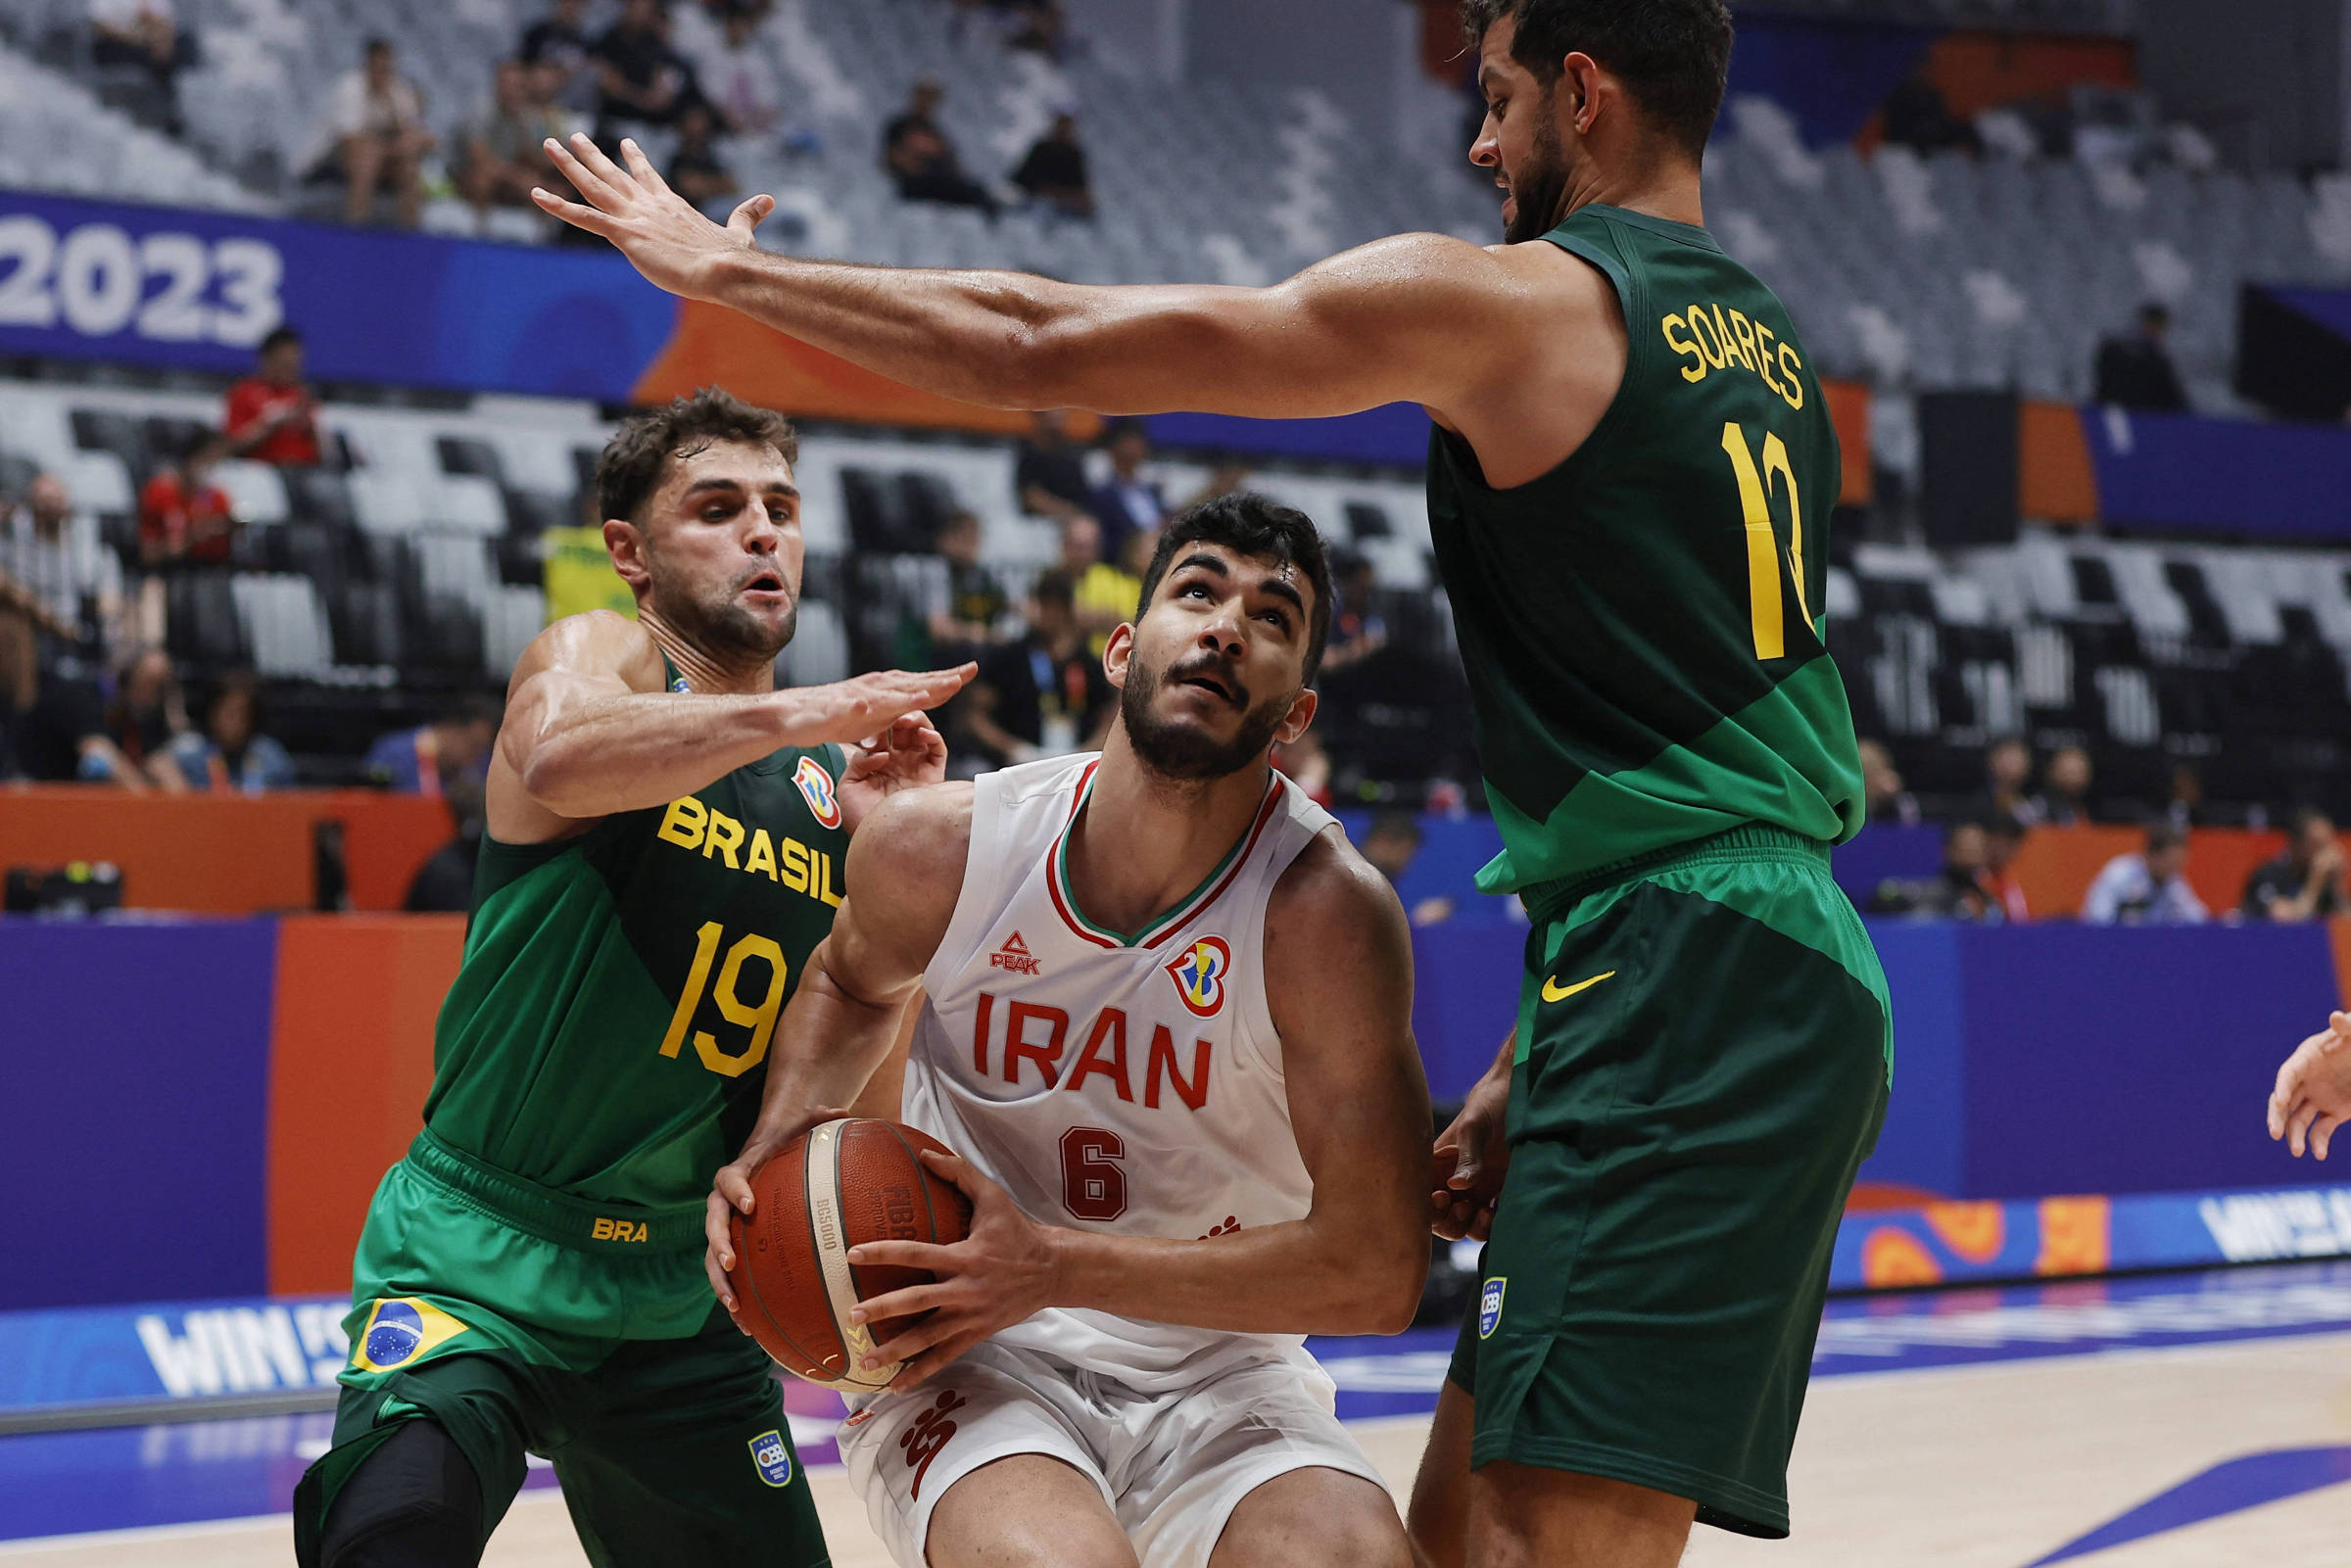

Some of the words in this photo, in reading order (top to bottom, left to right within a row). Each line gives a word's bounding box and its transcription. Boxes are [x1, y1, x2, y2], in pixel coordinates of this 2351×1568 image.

[0, 212, 284, 349] 2023
[1661, 304, 1803, 410] SOARES
[656, 794, 844, 909] BRASIL
[658, 921, 788, 1078] 19
[989, 952, 1041, 975] PEAK
[974, 990, 1213, 1111] IRAN
[885, 1185, 918, 1240] FIBA
[1058, 1126, 1128, 1222] 6
[591, 1217, 648, 1243] BRA
[816, 1198, 839, 1251] BG5000
[135, 1305, 310, 1399] WIN
